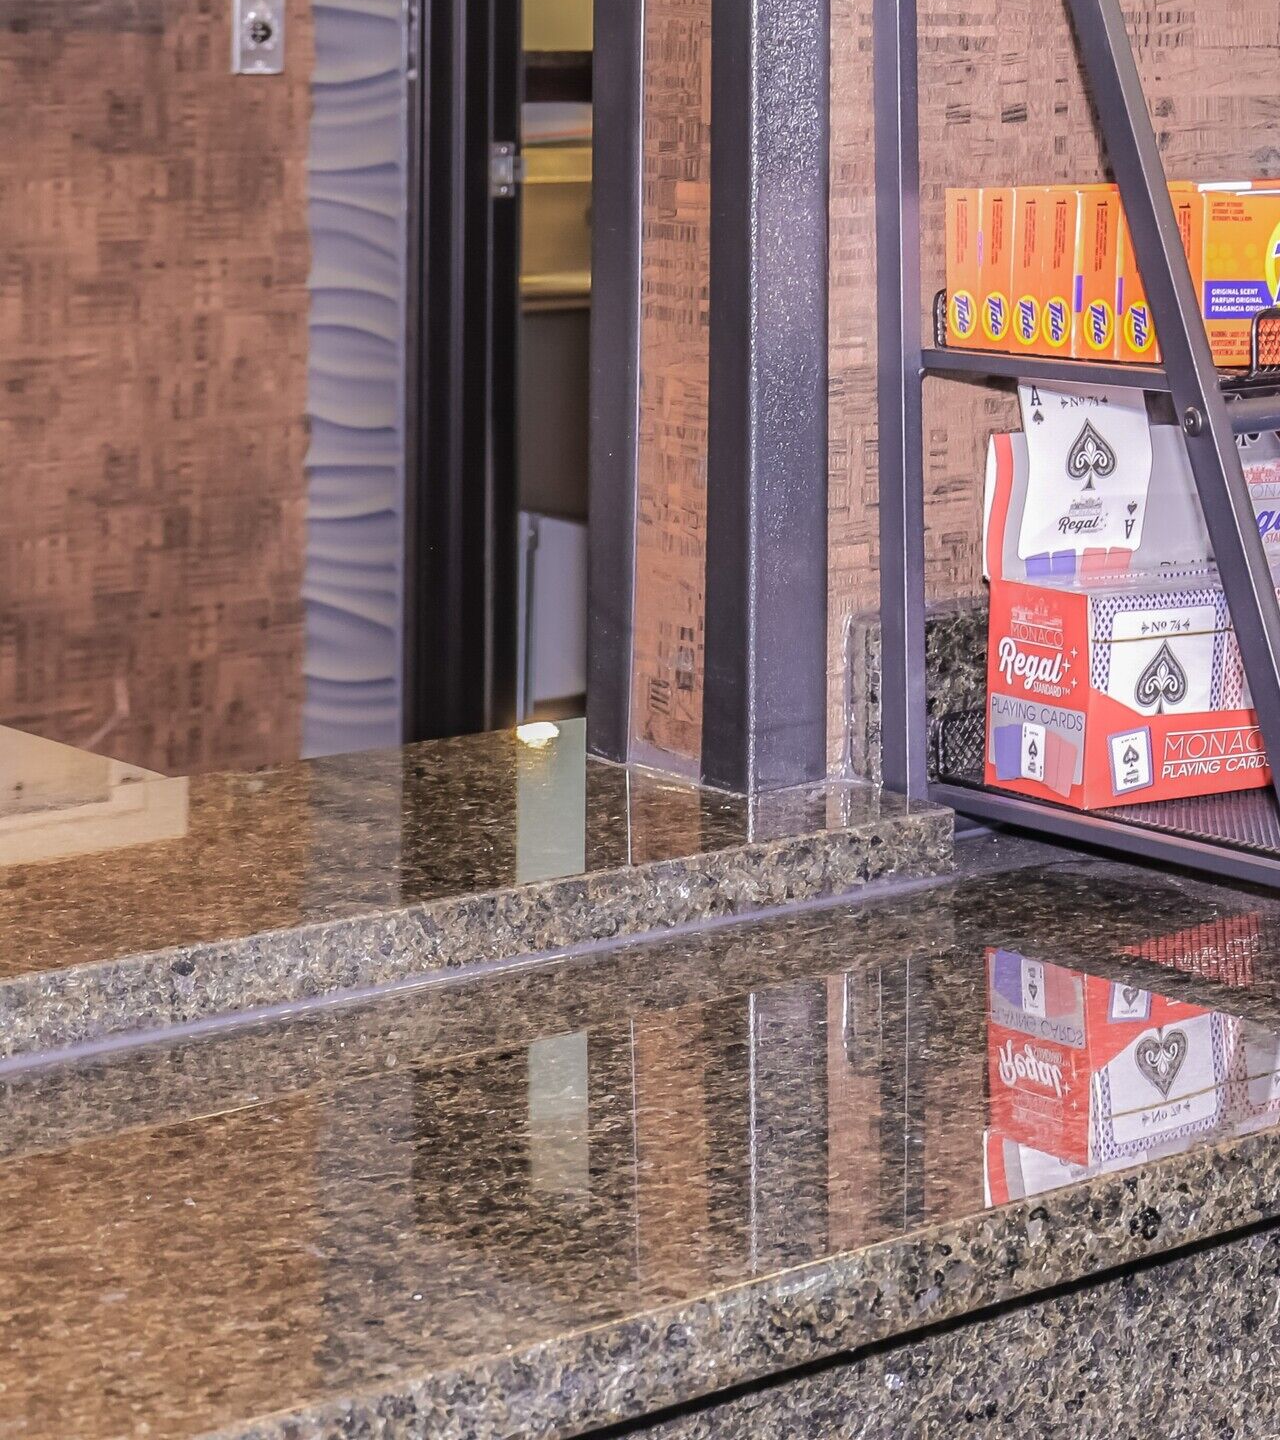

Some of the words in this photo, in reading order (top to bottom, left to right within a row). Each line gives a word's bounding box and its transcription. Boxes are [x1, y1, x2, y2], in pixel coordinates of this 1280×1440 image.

[1211, 288, 1239, 296] ORIGINAL
[1211, 296, 1235, 304] PARFUM
[1235, 296, 1263, 304] ORIGINAL
[1211, 304, 1245, 312] FRAGANCIA
[953, 295, 969, 334] Tide
[987, 297, 1003, 337] Tide
[1019, 300, 1035, 340] Tide
[1048, 303, 1064, 343] Tide
[1090, 304, 1107, 346] Tide
[1130, 307, 1147, 348] Tide
[1030, 385, 1042, 406] A
[1058, 515, 1100, 534] Regal
[1010, 623, 1064, 648] MONACO
[1169, 620, 1182, 633] 74
[998, 637, 1062, 690] Regal
[992, 696, 1042, 722] PLAYING
[1040, 708, 1084, 732] CARDS
[1164, 728, 1263, 761] MONAC
[1161, 763, 1221, 779] PLAYING
